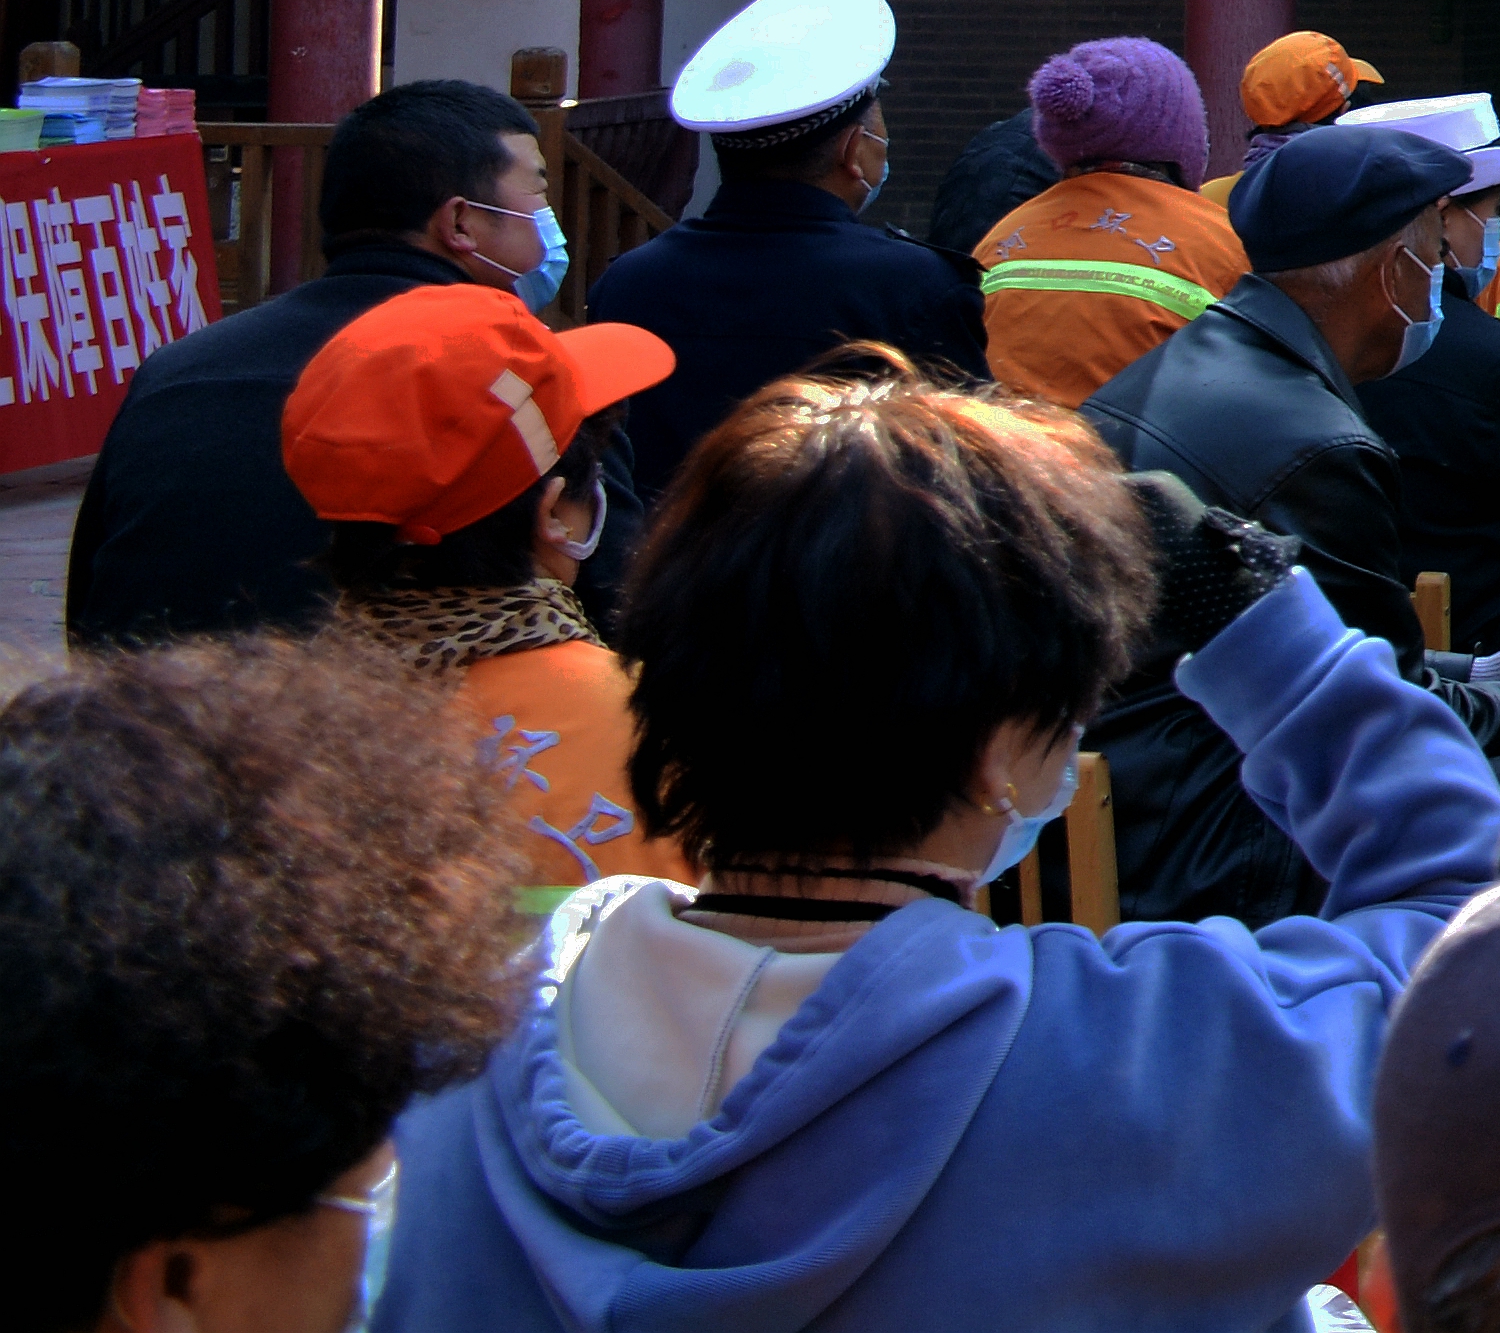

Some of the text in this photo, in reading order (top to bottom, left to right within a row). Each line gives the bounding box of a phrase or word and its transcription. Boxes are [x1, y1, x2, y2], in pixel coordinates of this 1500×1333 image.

[0, 174, 209, 406] 保障百姓家
